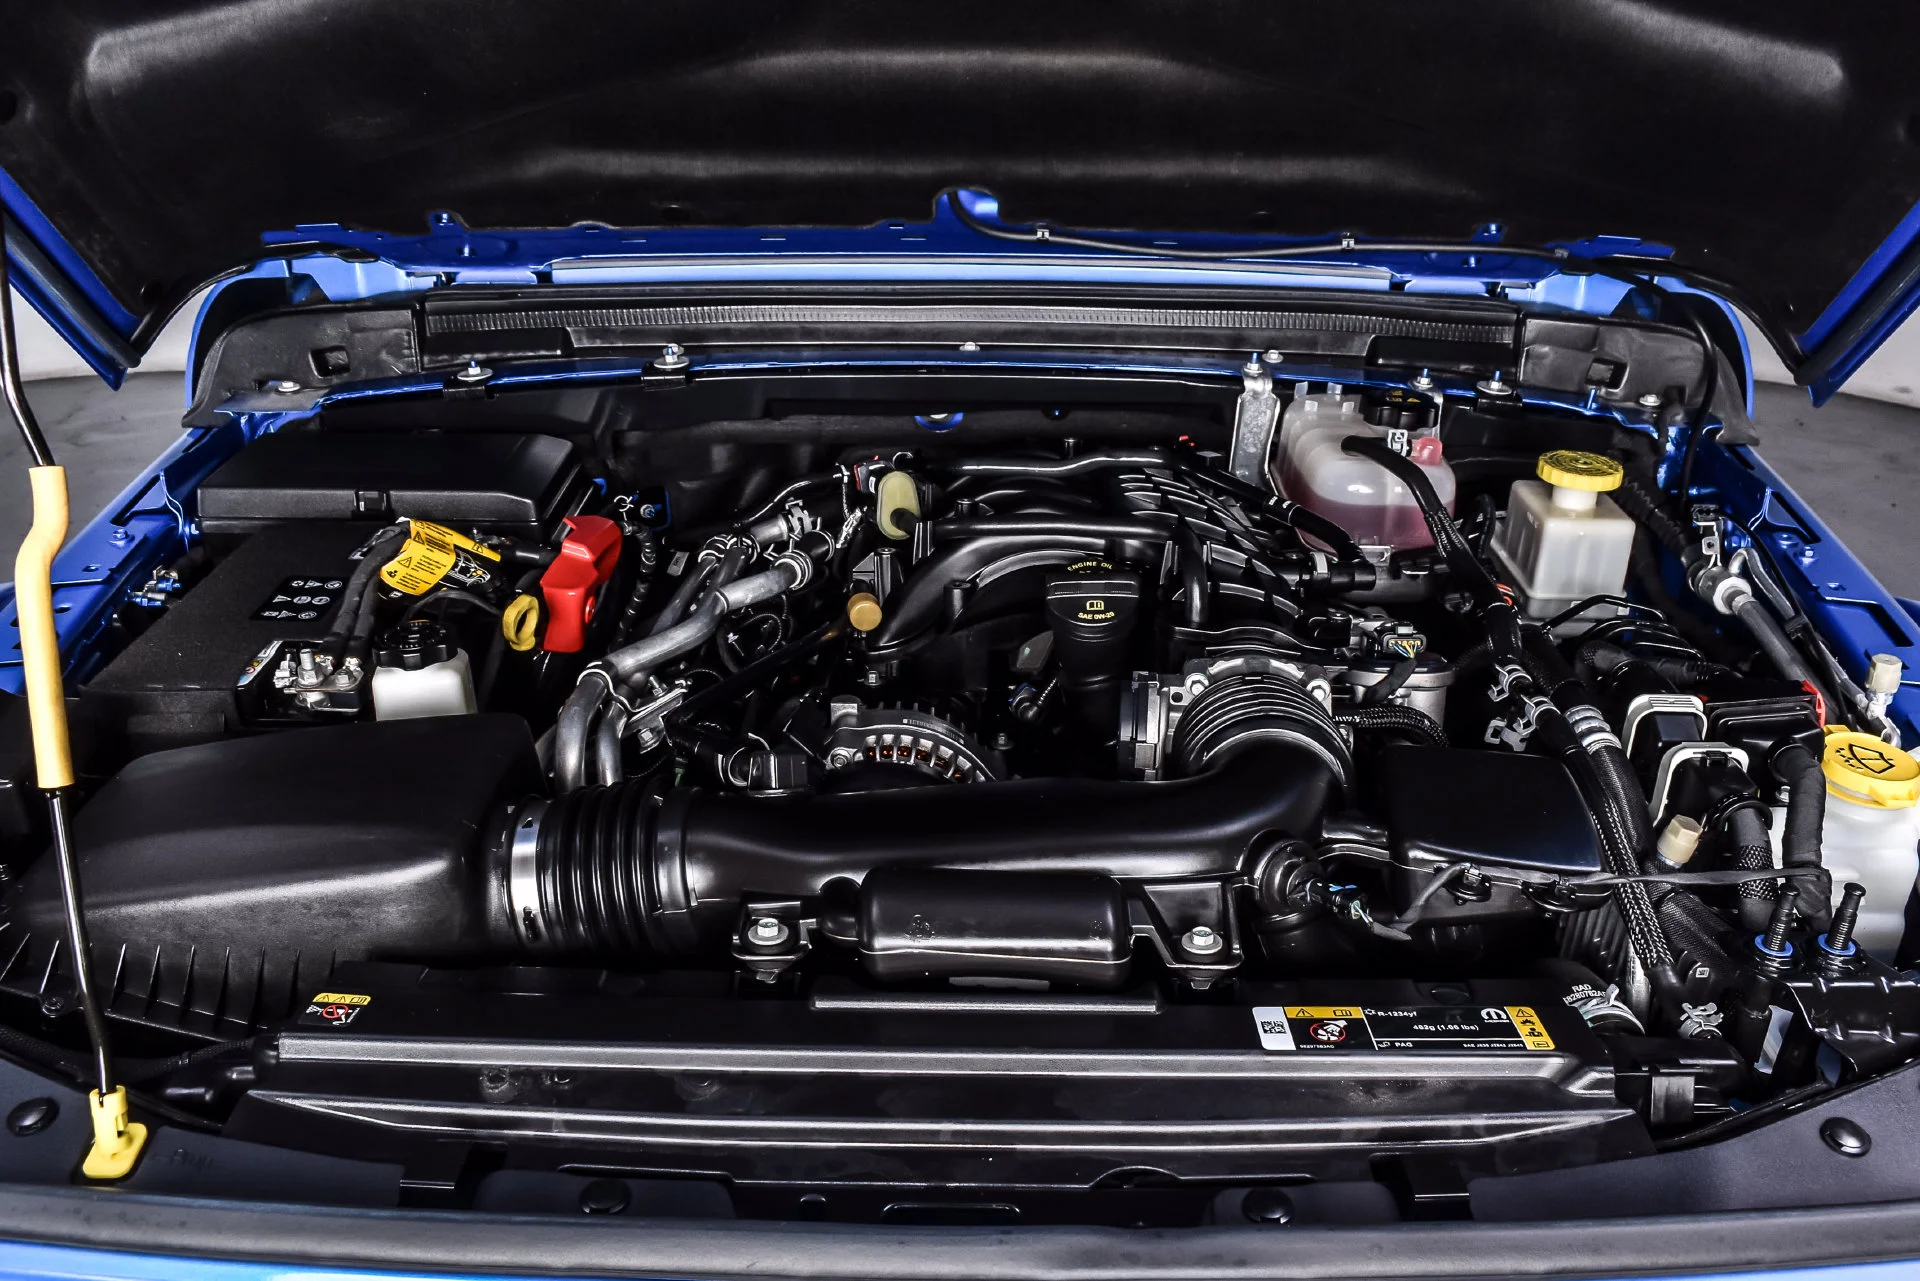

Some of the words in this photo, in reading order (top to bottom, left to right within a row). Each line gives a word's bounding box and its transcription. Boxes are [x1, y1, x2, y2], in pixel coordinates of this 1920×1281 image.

[1067, 561, 1097, 571] ENGINE
[1101, 562, 1113, 570] OIL
[1571, 983, 1592, 993] RAD
